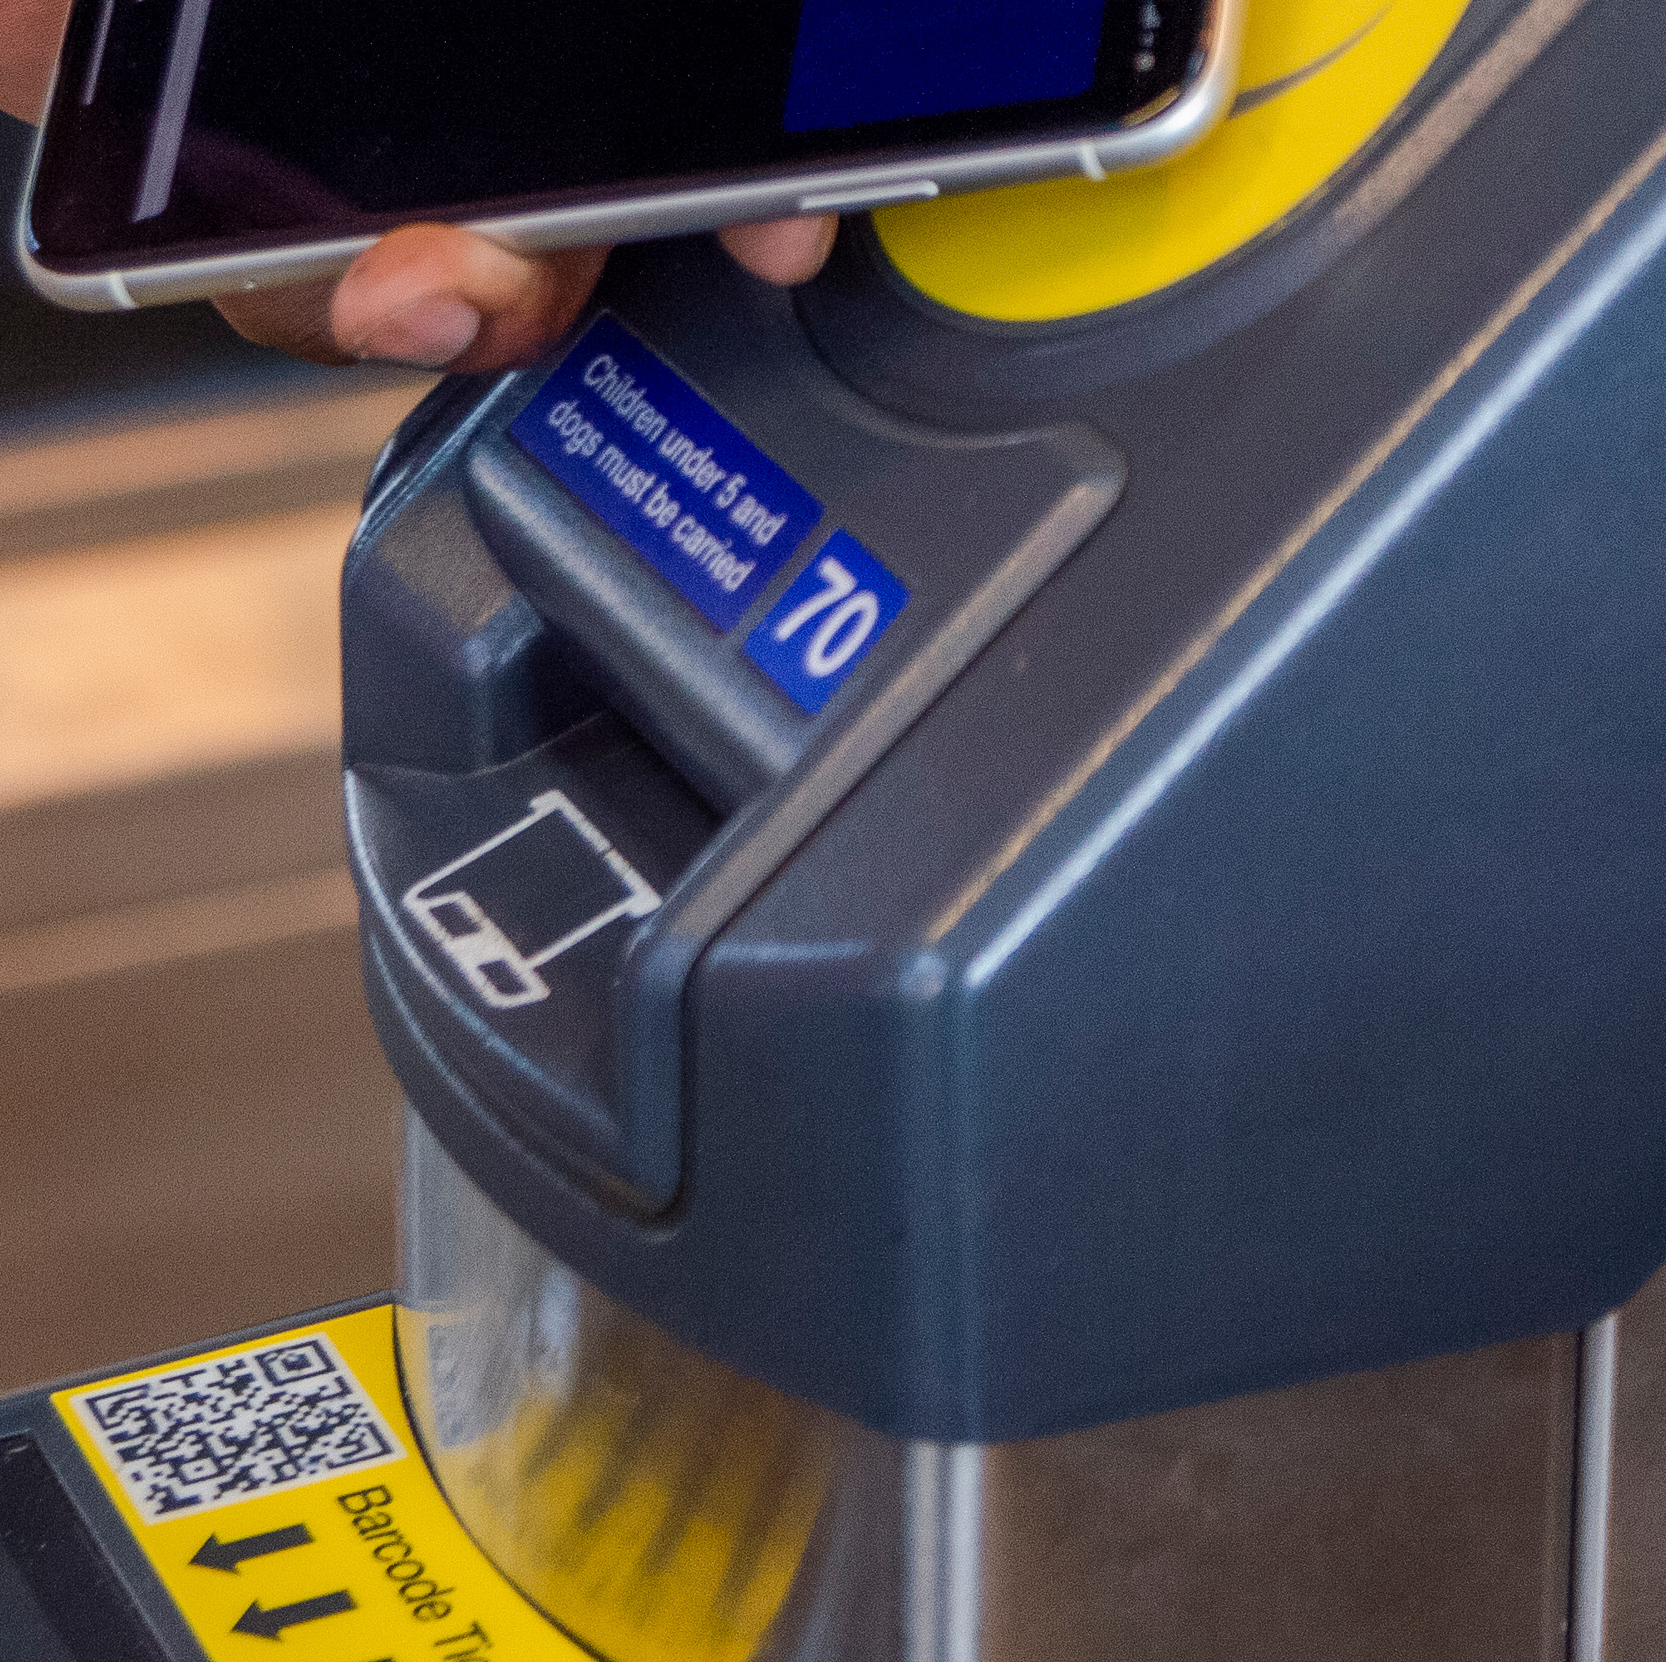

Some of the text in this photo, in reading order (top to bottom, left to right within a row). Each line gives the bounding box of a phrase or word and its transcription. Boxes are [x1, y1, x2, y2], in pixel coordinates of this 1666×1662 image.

[548, 399, 758, 593] dogs must be carried
[583, 353, 790, 547] Children under 5 and
[772, 556, 880, 680] 70
[336, 1483, 457, 1624] Barcode
